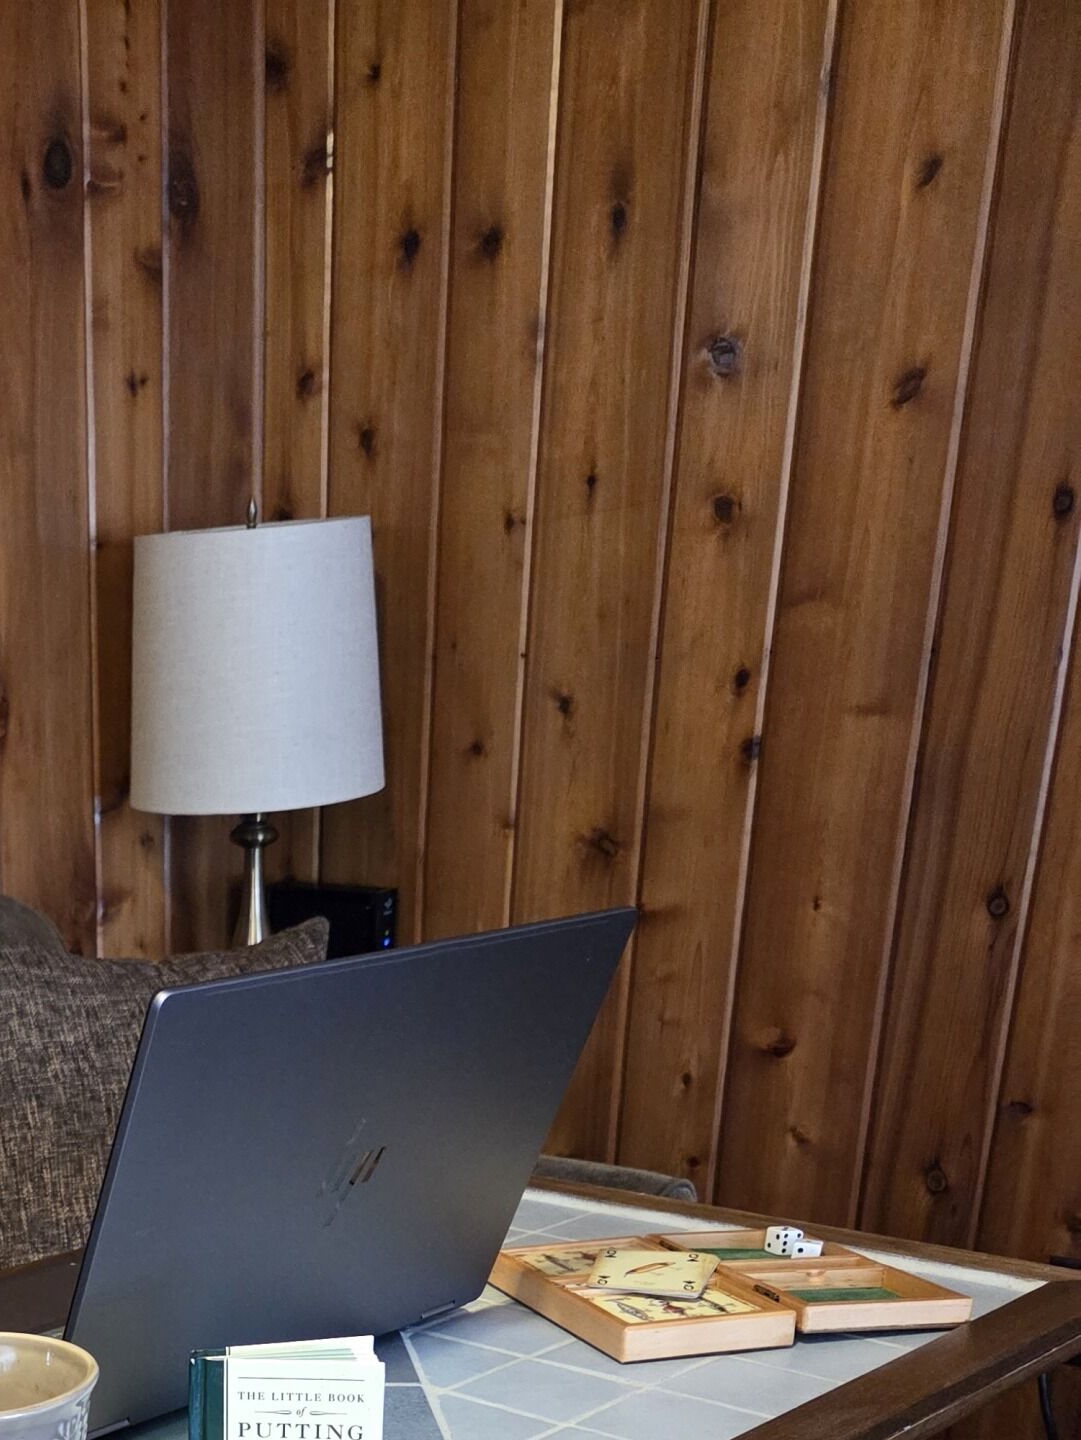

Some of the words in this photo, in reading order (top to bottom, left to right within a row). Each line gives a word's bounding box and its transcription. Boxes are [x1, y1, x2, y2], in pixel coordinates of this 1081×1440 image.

[237, 1391, 265, 1401] THE
[271, 1392, 322, 1402] LITTLE
[328, 1393, 365, 1403] BOOK
[296, 1406, 307, 1417] of
[237, 1421, 364, 1440] PUTTING
